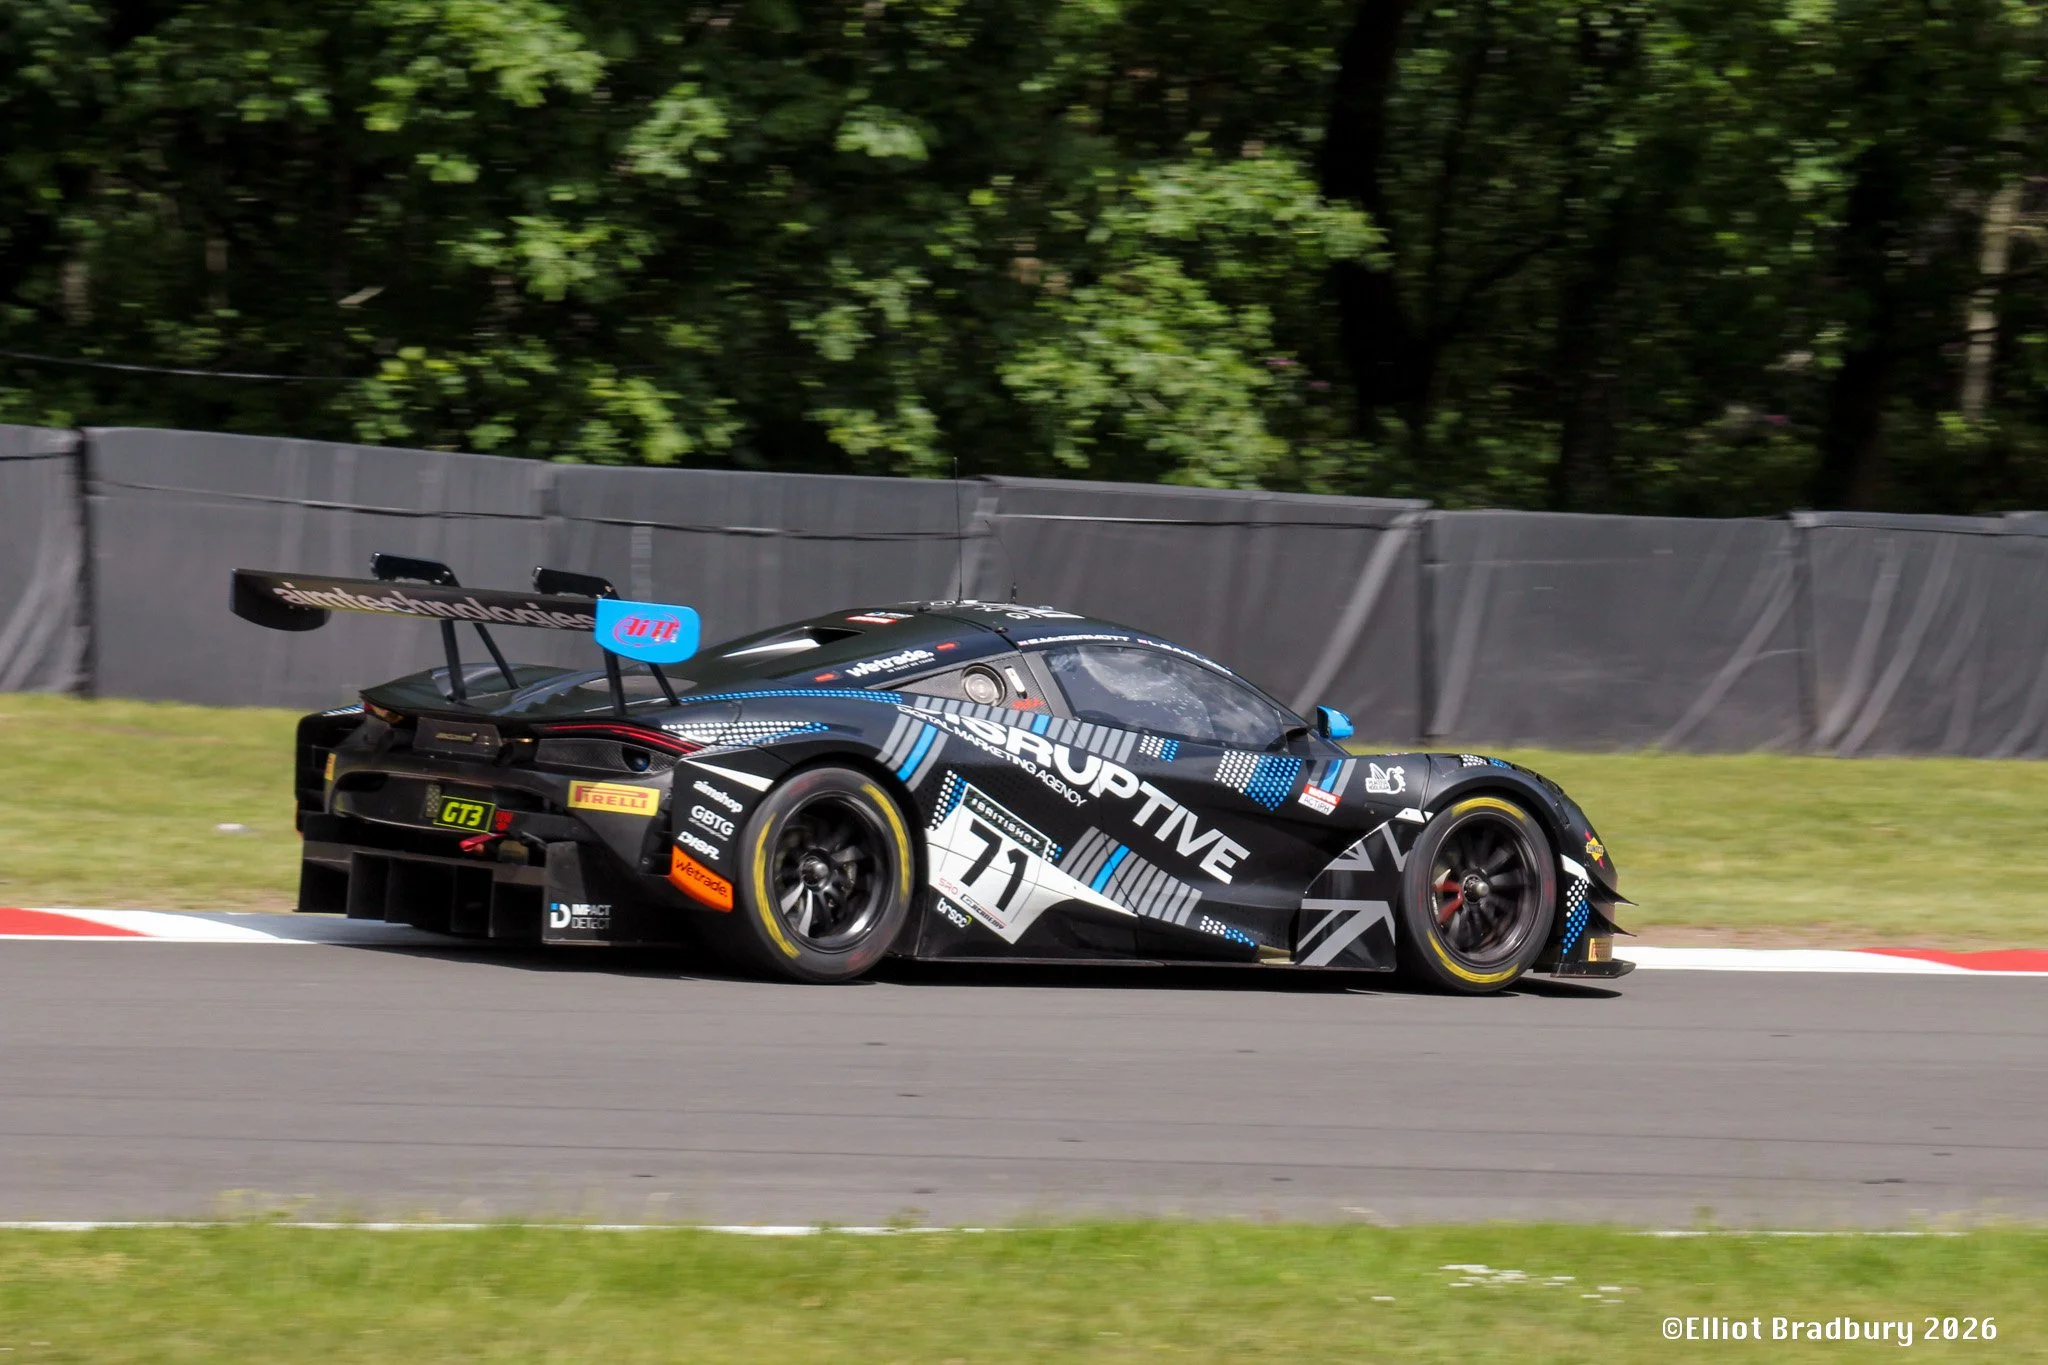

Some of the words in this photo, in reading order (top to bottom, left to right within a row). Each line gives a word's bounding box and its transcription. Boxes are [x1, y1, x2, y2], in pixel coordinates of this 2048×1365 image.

[896, 705, 954, 733] DIGITAL
[952, 729, 1037, 775] MARKETING
[1035, 770, 1088, 808] AGENCY
[575, 785, 650, 809] PIRELLI
[442, 801, 484, 826] GT3
[691, 805, 735, 836] GBTG
[960, 818, 1029, 913] 71
[571, 917, 611, 930] DETECT
[572, 904, 612, 916] IMPACT
[937, 897, 968, 928] brscc
